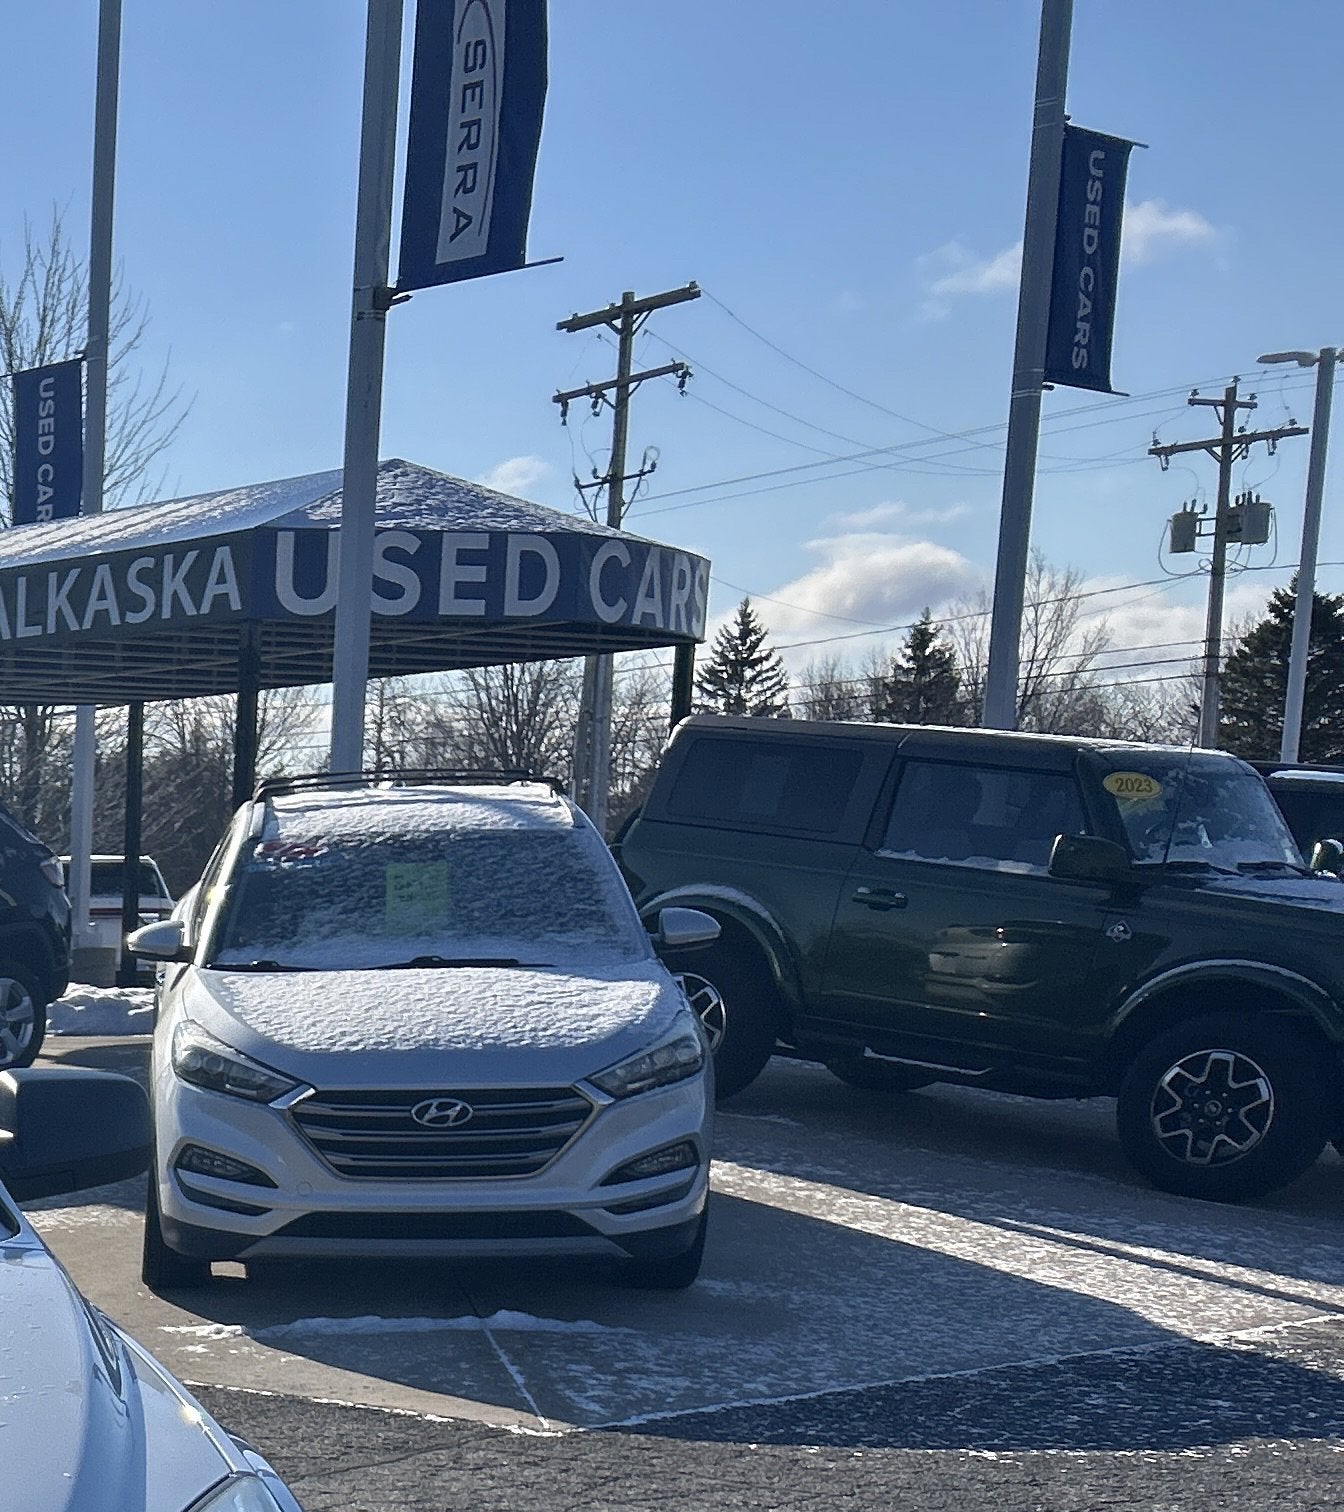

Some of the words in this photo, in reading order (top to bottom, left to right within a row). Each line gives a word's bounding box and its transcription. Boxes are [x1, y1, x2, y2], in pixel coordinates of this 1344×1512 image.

[449, 39, 486, 243] SERRA
[1083, 149, 1106, 255] USED
[1071, 266, 1095, 369] CARS
[38, 377, 55, 455] USED
[36, 463, 54, 522] CAR
[275, 531, 561, 616] USED
[589, 541, 708, 639] CARS
[1115, 777, 1153, 793] 2023
